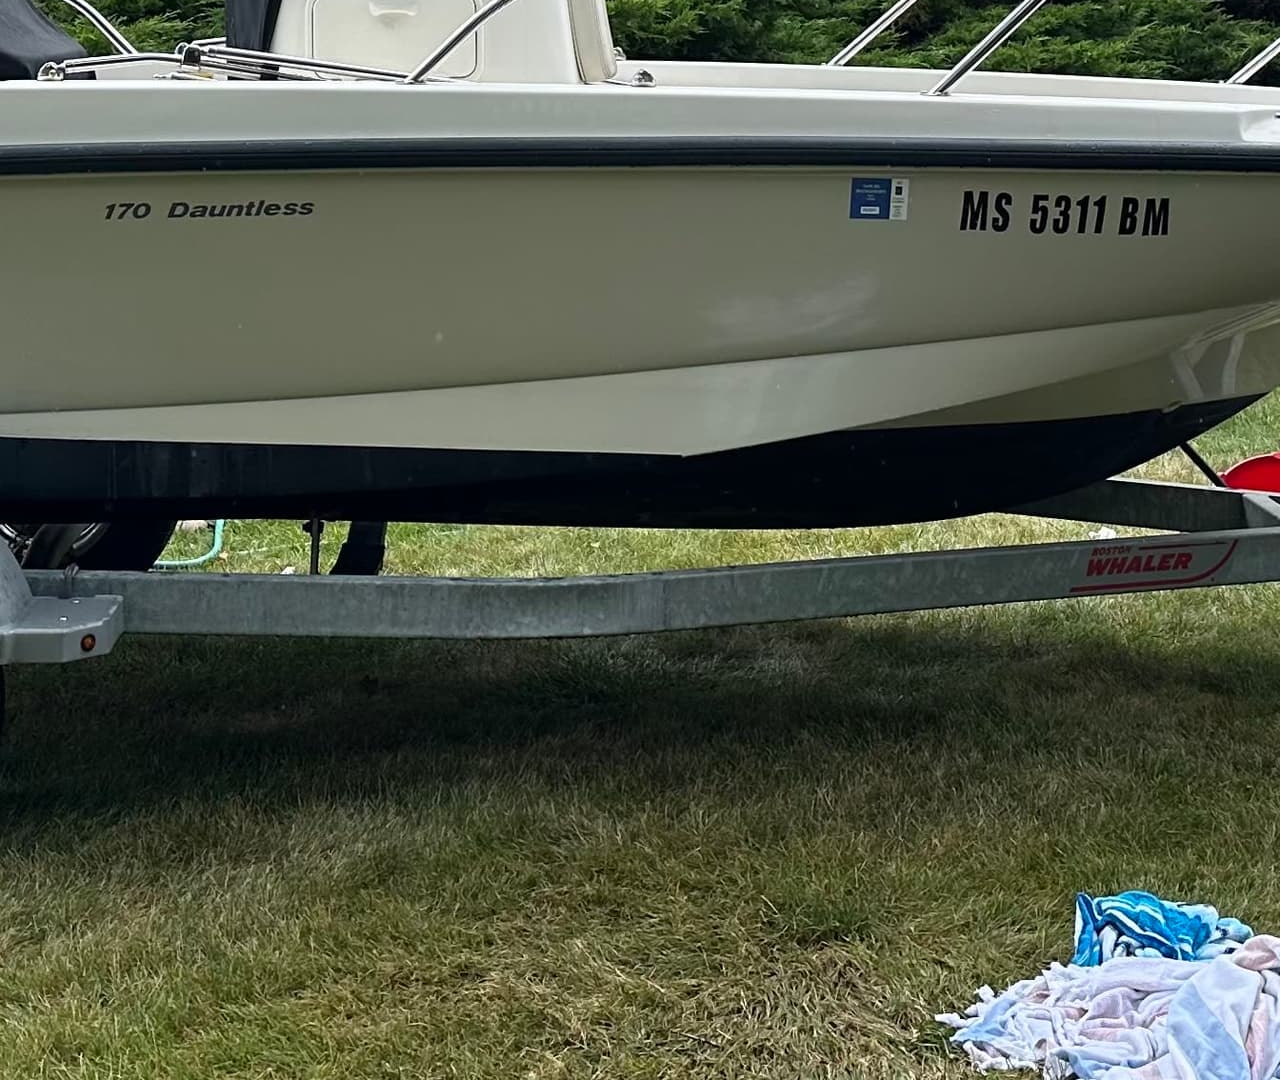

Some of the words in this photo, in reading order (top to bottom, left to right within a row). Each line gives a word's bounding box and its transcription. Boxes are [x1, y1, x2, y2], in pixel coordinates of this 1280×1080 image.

[105, 203, 151, 220] 170
[168, 200, 315, 218] Dauntless
[959, 190, 1013, 233] MS
[1029, 194, 1107, 235] 5311
[1118, 196, 1170, 237] BM
[1091, 545, 1133, 557] BOSTON
[1086, 552, 1193, 577] WHALER
